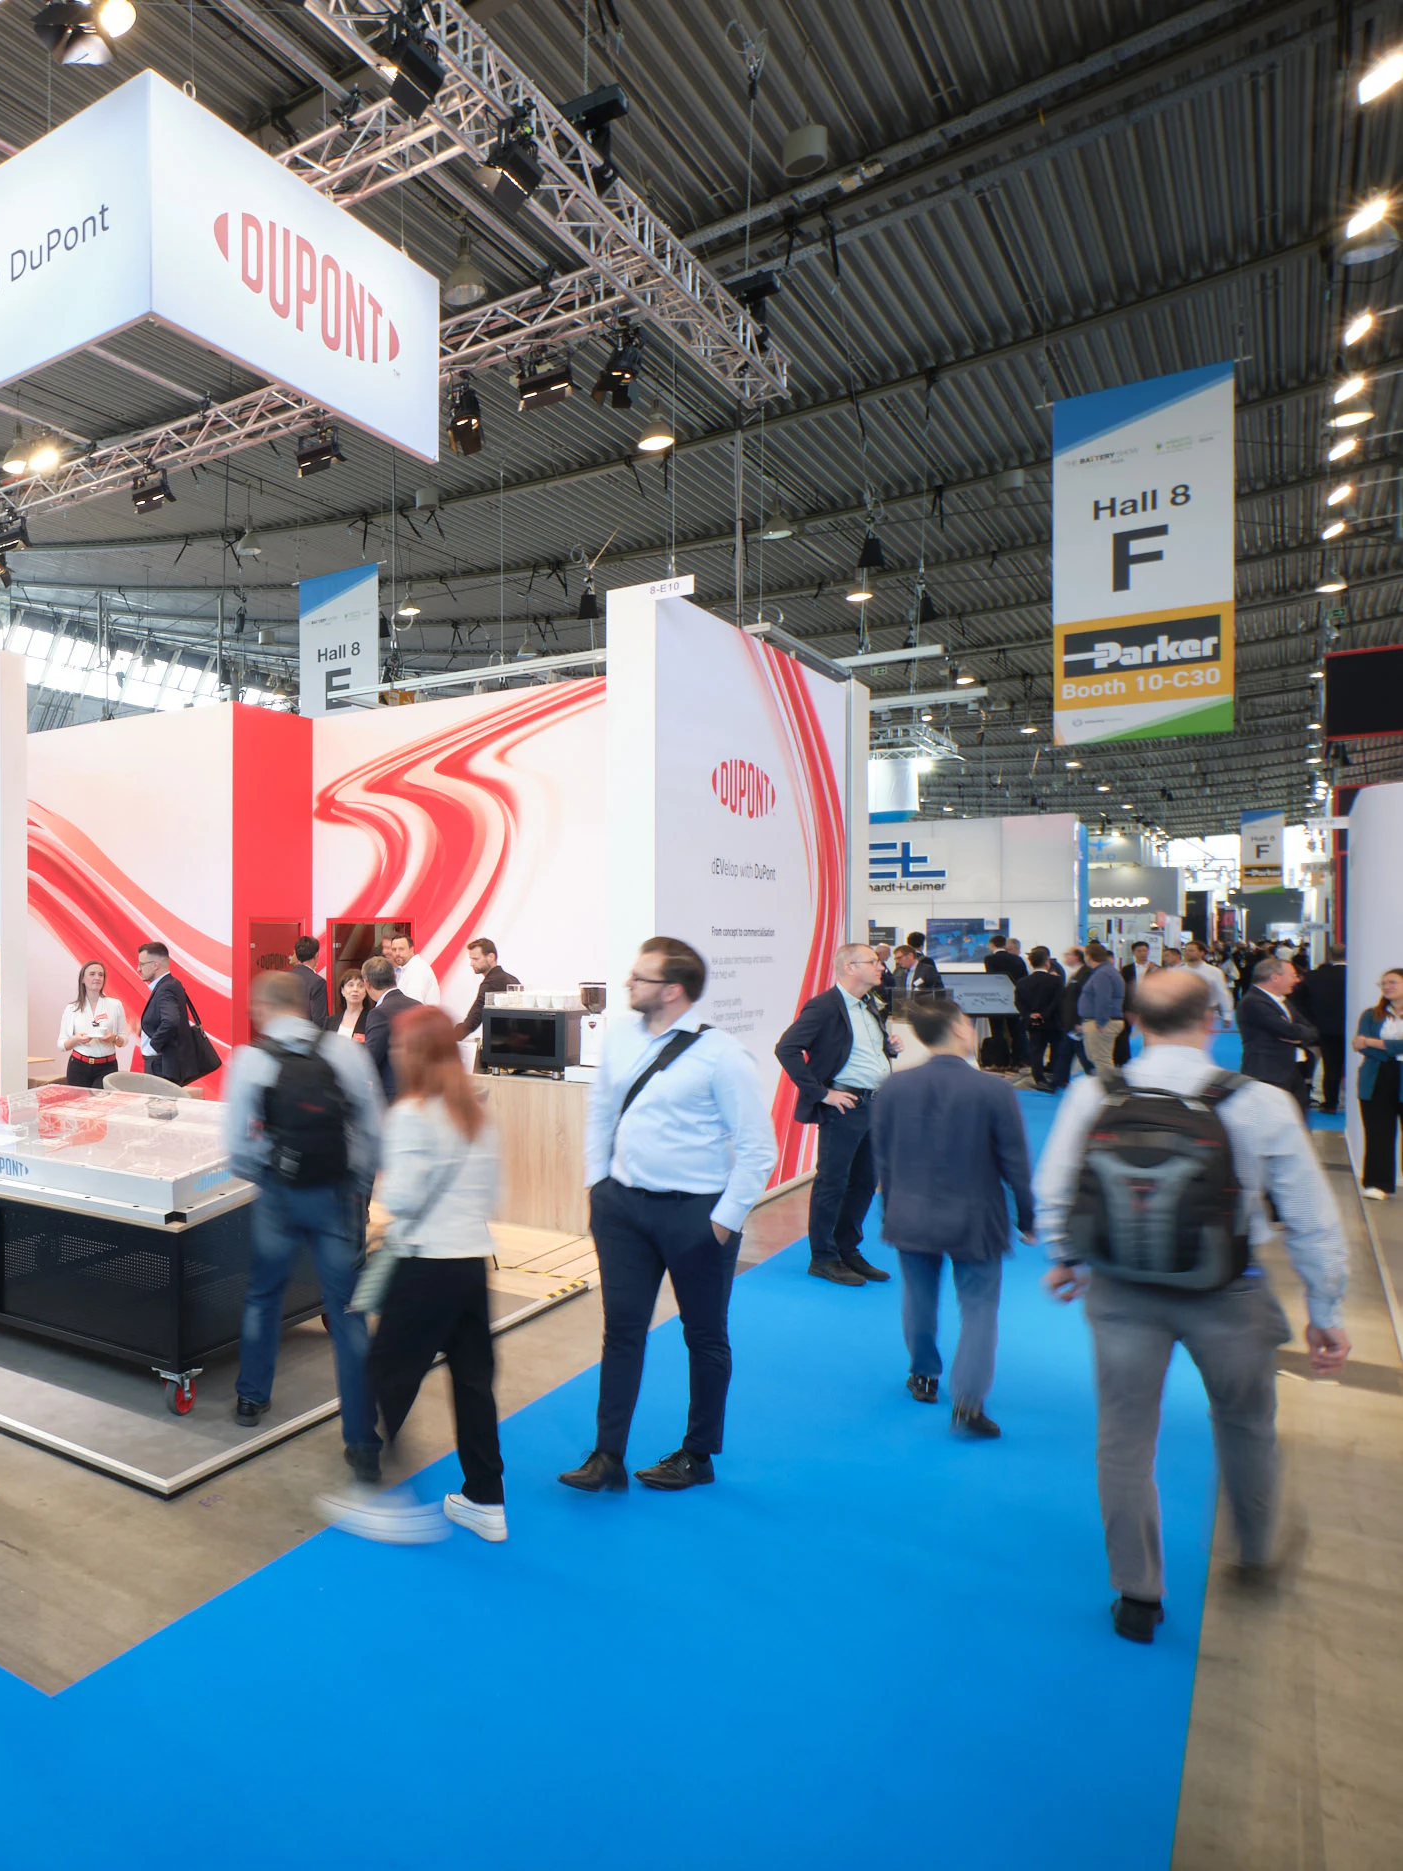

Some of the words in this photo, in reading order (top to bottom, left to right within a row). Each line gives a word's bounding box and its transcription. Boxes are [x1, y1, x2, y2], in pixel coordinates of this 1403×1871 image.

[11, 204, 109, 282] DuPont
[241, 212, 383, 364] DUPONT
[1079, 451, 1115, 465] BATTERY
[1093, 489, 1158, 521] Hall
[1170, 484, 1191, 507] 8
[1112, 524, 1169, 592] F
[649, 581, 680, 595] 8-E10
[317, 643, 346, 663] Hall
[351, 641, 361, 656] 8
[1063, 635, 1218, 669] Parker
[325, 667, 352, 711] E
[1061, 678, 1126, 700] Booth
[1137, 667, 1220, 692] 10-C30
[720, 759, 770, 819] DUPONT
[1255, 844, 1270, 859] F
[712, 857, 738, 880] dEVelop
[740, 862, 753, 878] with
[754, 863, 776, 881] DuPont
[869, 882, 946, 892] ardt+Leimer
[1088, 897, 1149, 907] GROUP
